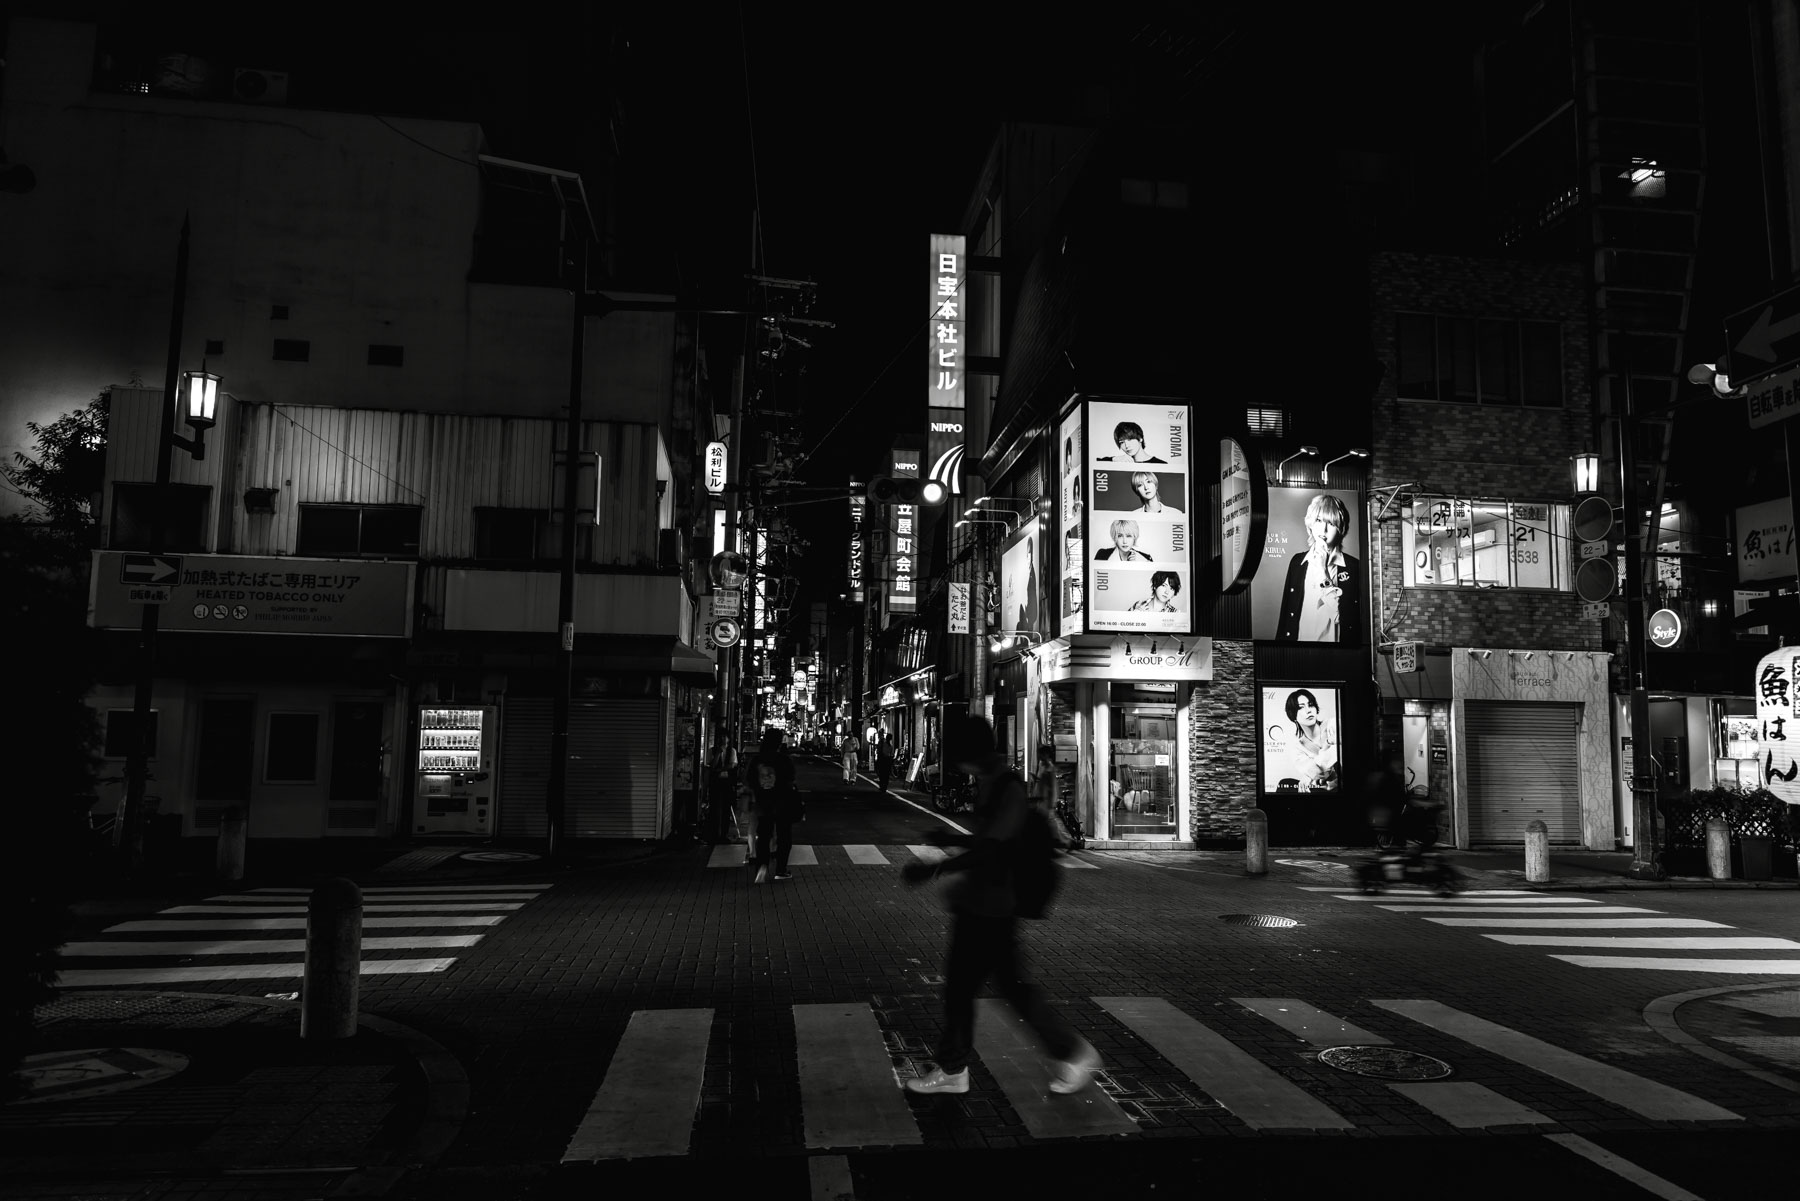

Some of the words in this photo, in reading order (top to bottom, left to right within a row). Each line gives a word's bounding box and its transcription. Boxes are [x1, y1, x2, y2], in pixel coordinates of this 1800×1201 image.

[937, 253, 958, 391] 日宝本社ビル
[930, 423, 963, 433] NIPPO
[1169, 425, 1182, 458] RYOMA
[710, 446, 722, 488] 松利ビル
[894, 462, 918, 470] NIPPO
[1095, 472, 1109, 492] SHO
[1432, 512, 1447, 526] 21
[850, 507, 862, 588] ニューグランドビル
[1172, 523, 1184, 552] KIRUA
[1510, 549, 1539, 564] 3538
[183, 568, 361, 590] 加熱式たばこ専用エリア
[1096, 570, 1108, 591] JIRO
[196, 589, 245, 601] HEATED
[249, 591, 309, 602] TOBACCO
[312, 593, 345, 604] ONLY
[1652, 625, 1677, 640] Style
[1129, 655, 1163, 665] GROUP
[1165, 650, 1192, 667] M
[1759, 663, 1798, 786] 魚はん
